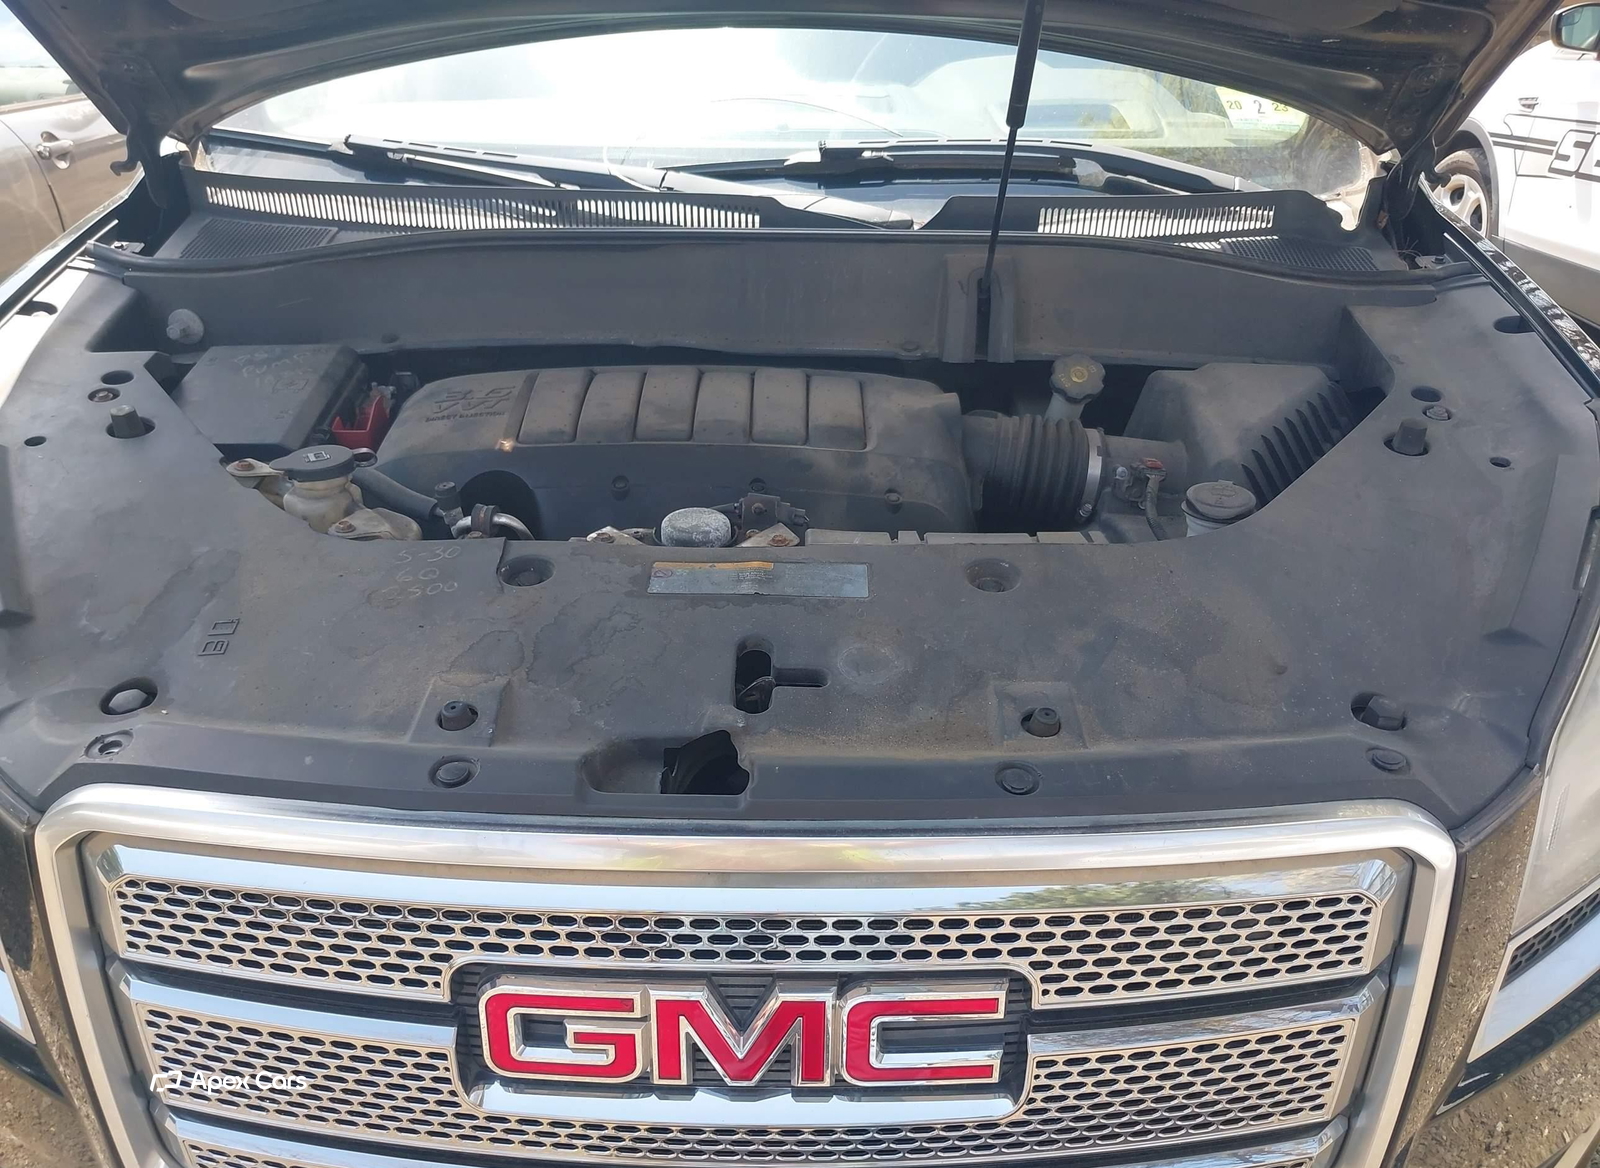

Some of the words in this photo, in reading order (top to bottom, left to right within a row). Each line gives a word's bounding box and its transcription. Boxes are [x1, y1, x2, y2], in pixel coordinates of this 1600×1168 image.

[1226, 99, 1243, 111] 20
[1253, 98, 1267, 115] 2
[480, 982, 1006, 1087] GMC
